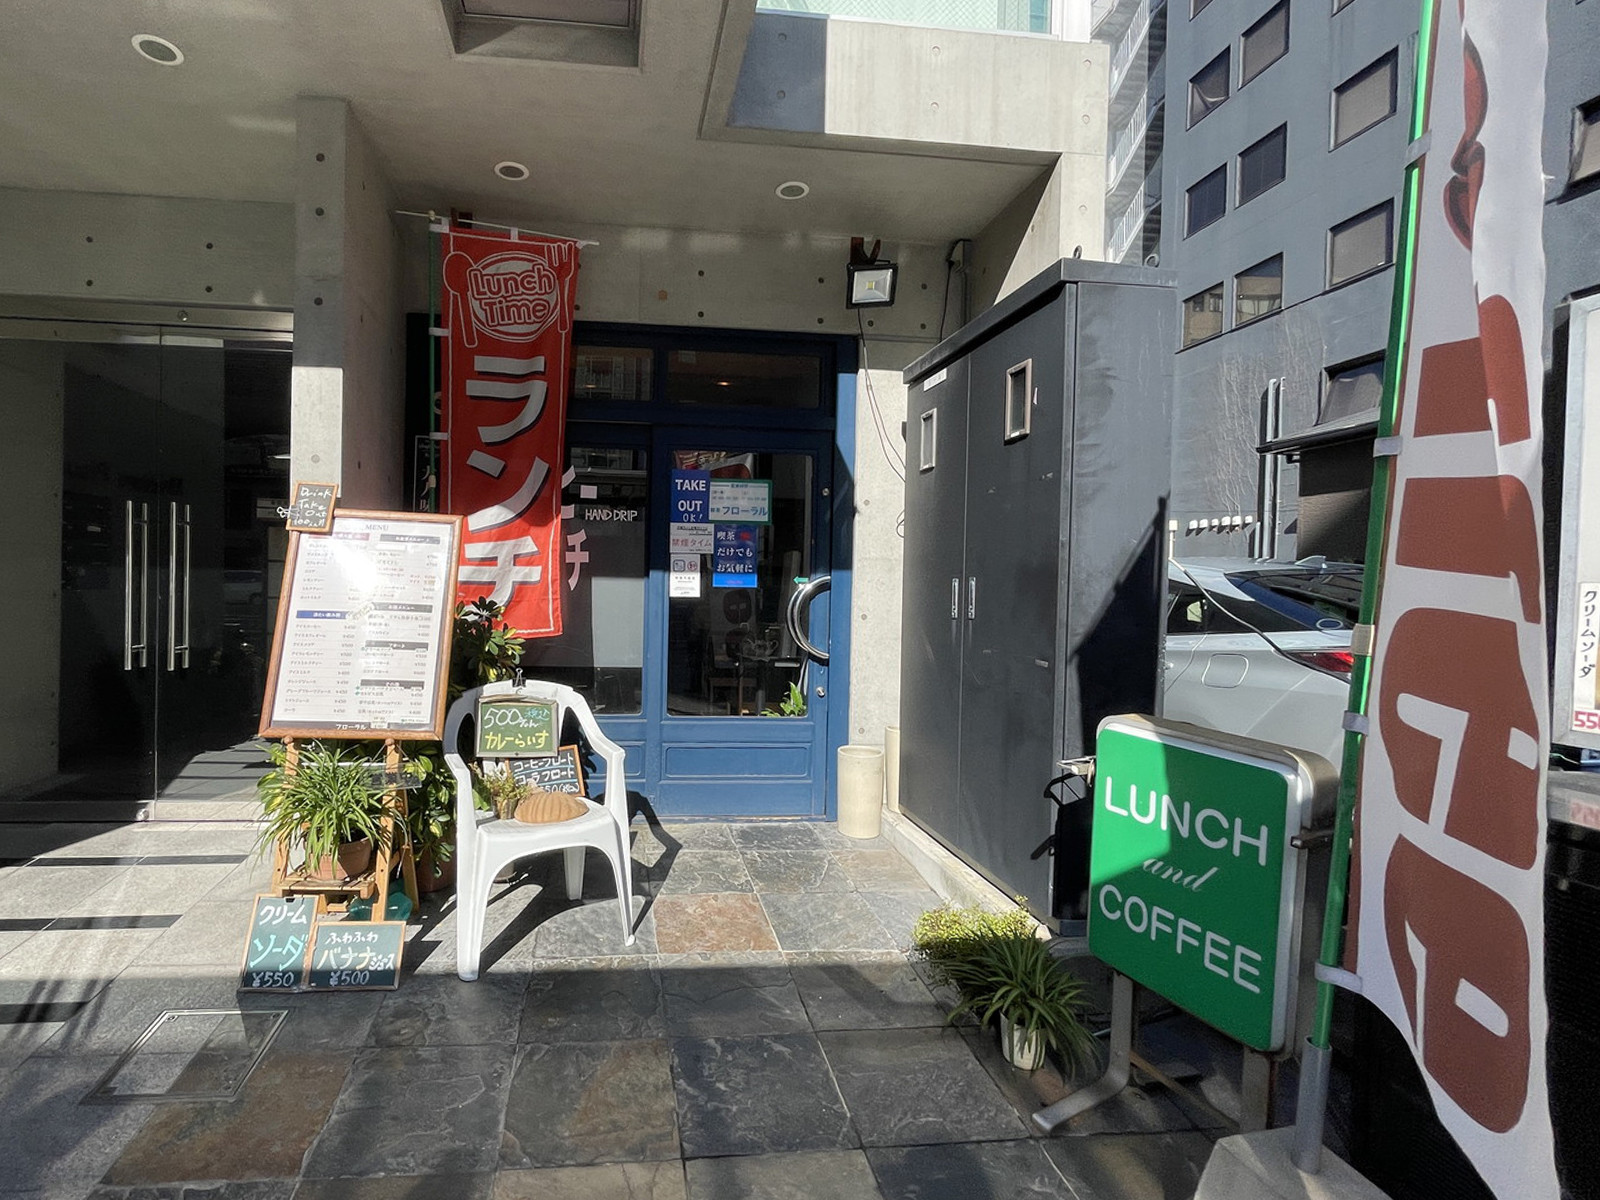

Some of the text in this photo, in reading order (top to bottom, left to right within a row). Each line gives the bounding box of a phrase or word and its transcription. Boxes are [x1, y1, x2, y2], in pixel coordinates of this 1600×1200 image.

[470, 265, 554, 298] Lunch
[481, 299, 549, 327] Time
[458, 355, 549, 621] ランチ
[675, 479, 706, 492] TAKE
[299, 498, 327, 510] Take
[677, 500, 703, 512] OUT
[722, 506, 768, 517] フローラル
[304, 509, 327, 518] Out
[585, 508, 638, 522] HAND DRIP
[365, 524, 389, 532] MENU
[672, 538, 712, 547] 禁煙タイム
[717, 531, 736, 541] 喫茶
[717, 547, 753, 557] だけでも
[716, 563, 753, 573] お気軽に
[1579, 590, 1597, 679] クリームソーダ
[336, 723, 367, 731] フローラル
[1574, 710, 1600, 730] 55
[485, 729, 549, 750] カレーらいす
[1104, 775, 1269, 867] LUNCH
[1142, 857, 1219, 892] and
[259, 904, 307, 926] クリーム
[325, 931, 379, 945] ふわふわ
[1099, 884, 1262, 994] COFFEE
[249, 933, 309, 972] ソーダ
[252, 971, 295, 988] ¥550
[329, 970, 370, 987] ¥500
